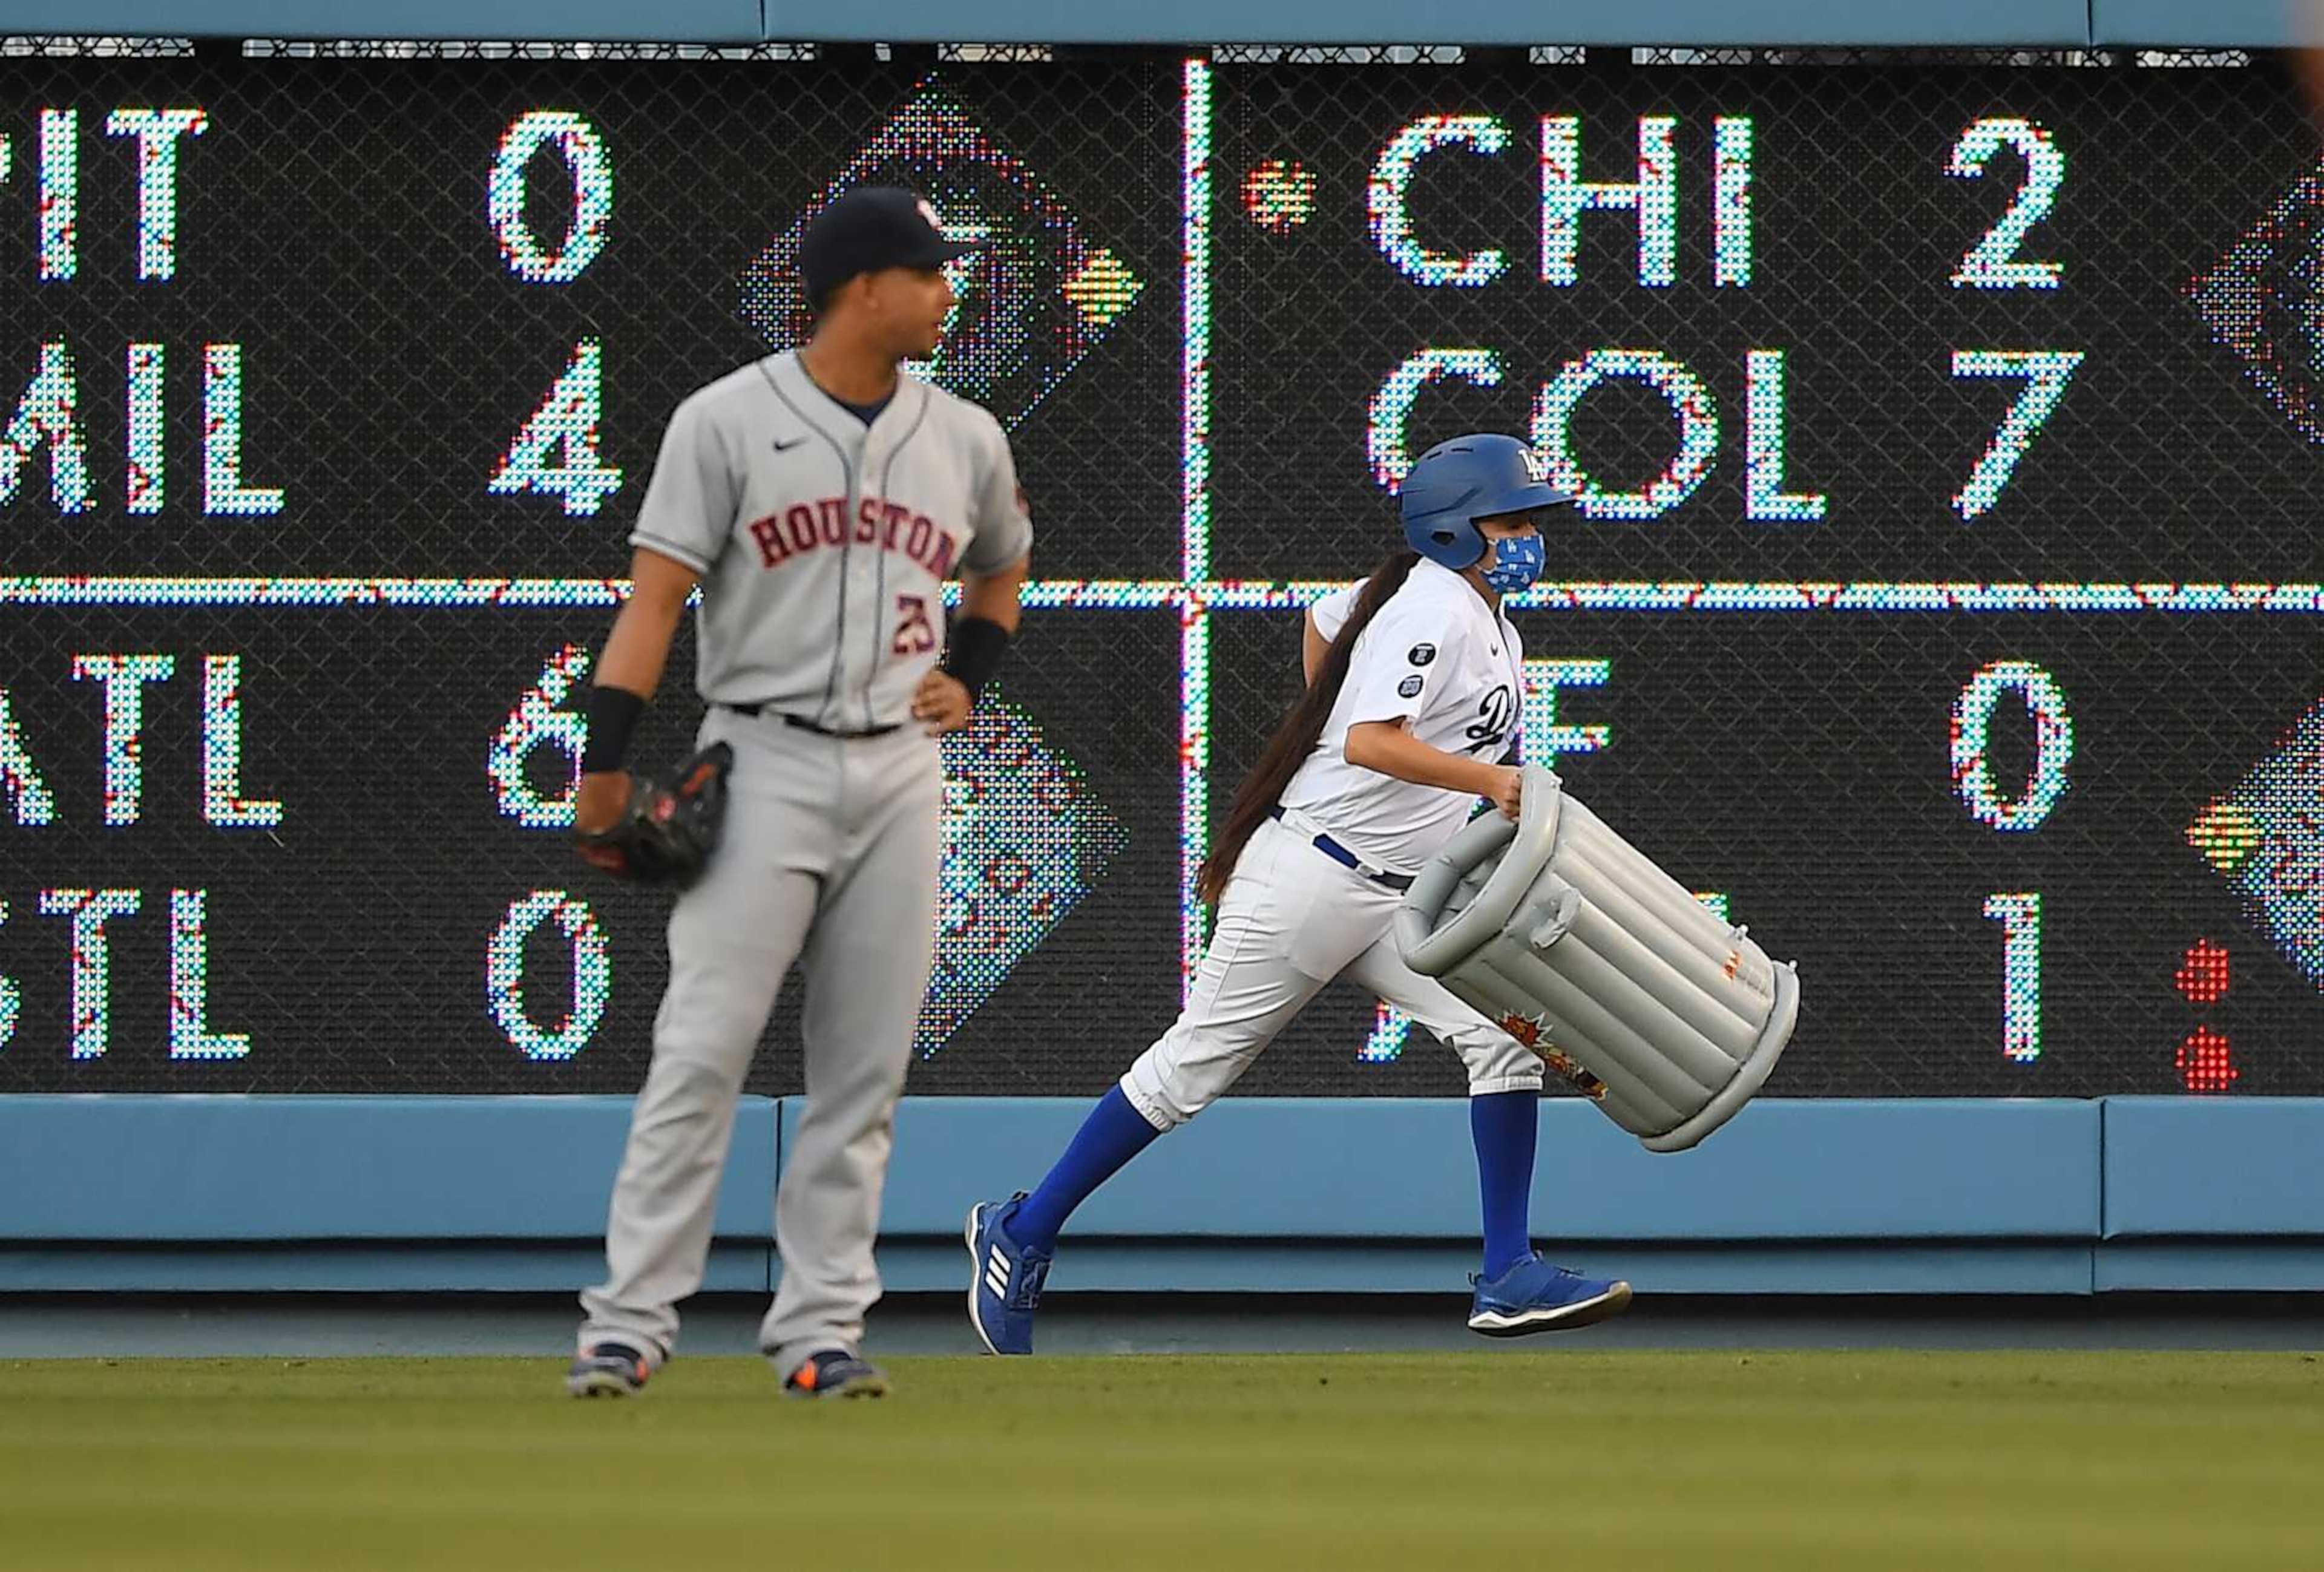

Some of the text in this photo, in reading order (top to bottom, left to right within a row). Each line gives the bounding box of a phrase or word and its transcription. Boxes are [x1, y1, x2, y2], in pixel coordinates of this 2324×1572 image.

[0, 109, 612, 283] IT 0
[1368, 114, 2064, 289] CHI 2
[488, 337, 623, 517] 4
[1368, 349, 2085, 520] COL 7
[488, 643, 589, 827] 6
[1951, 661, 2073, 831] 0
[0, 889, 610, 1060] TL 0
[1984, 892, 2041, 1062] 1
